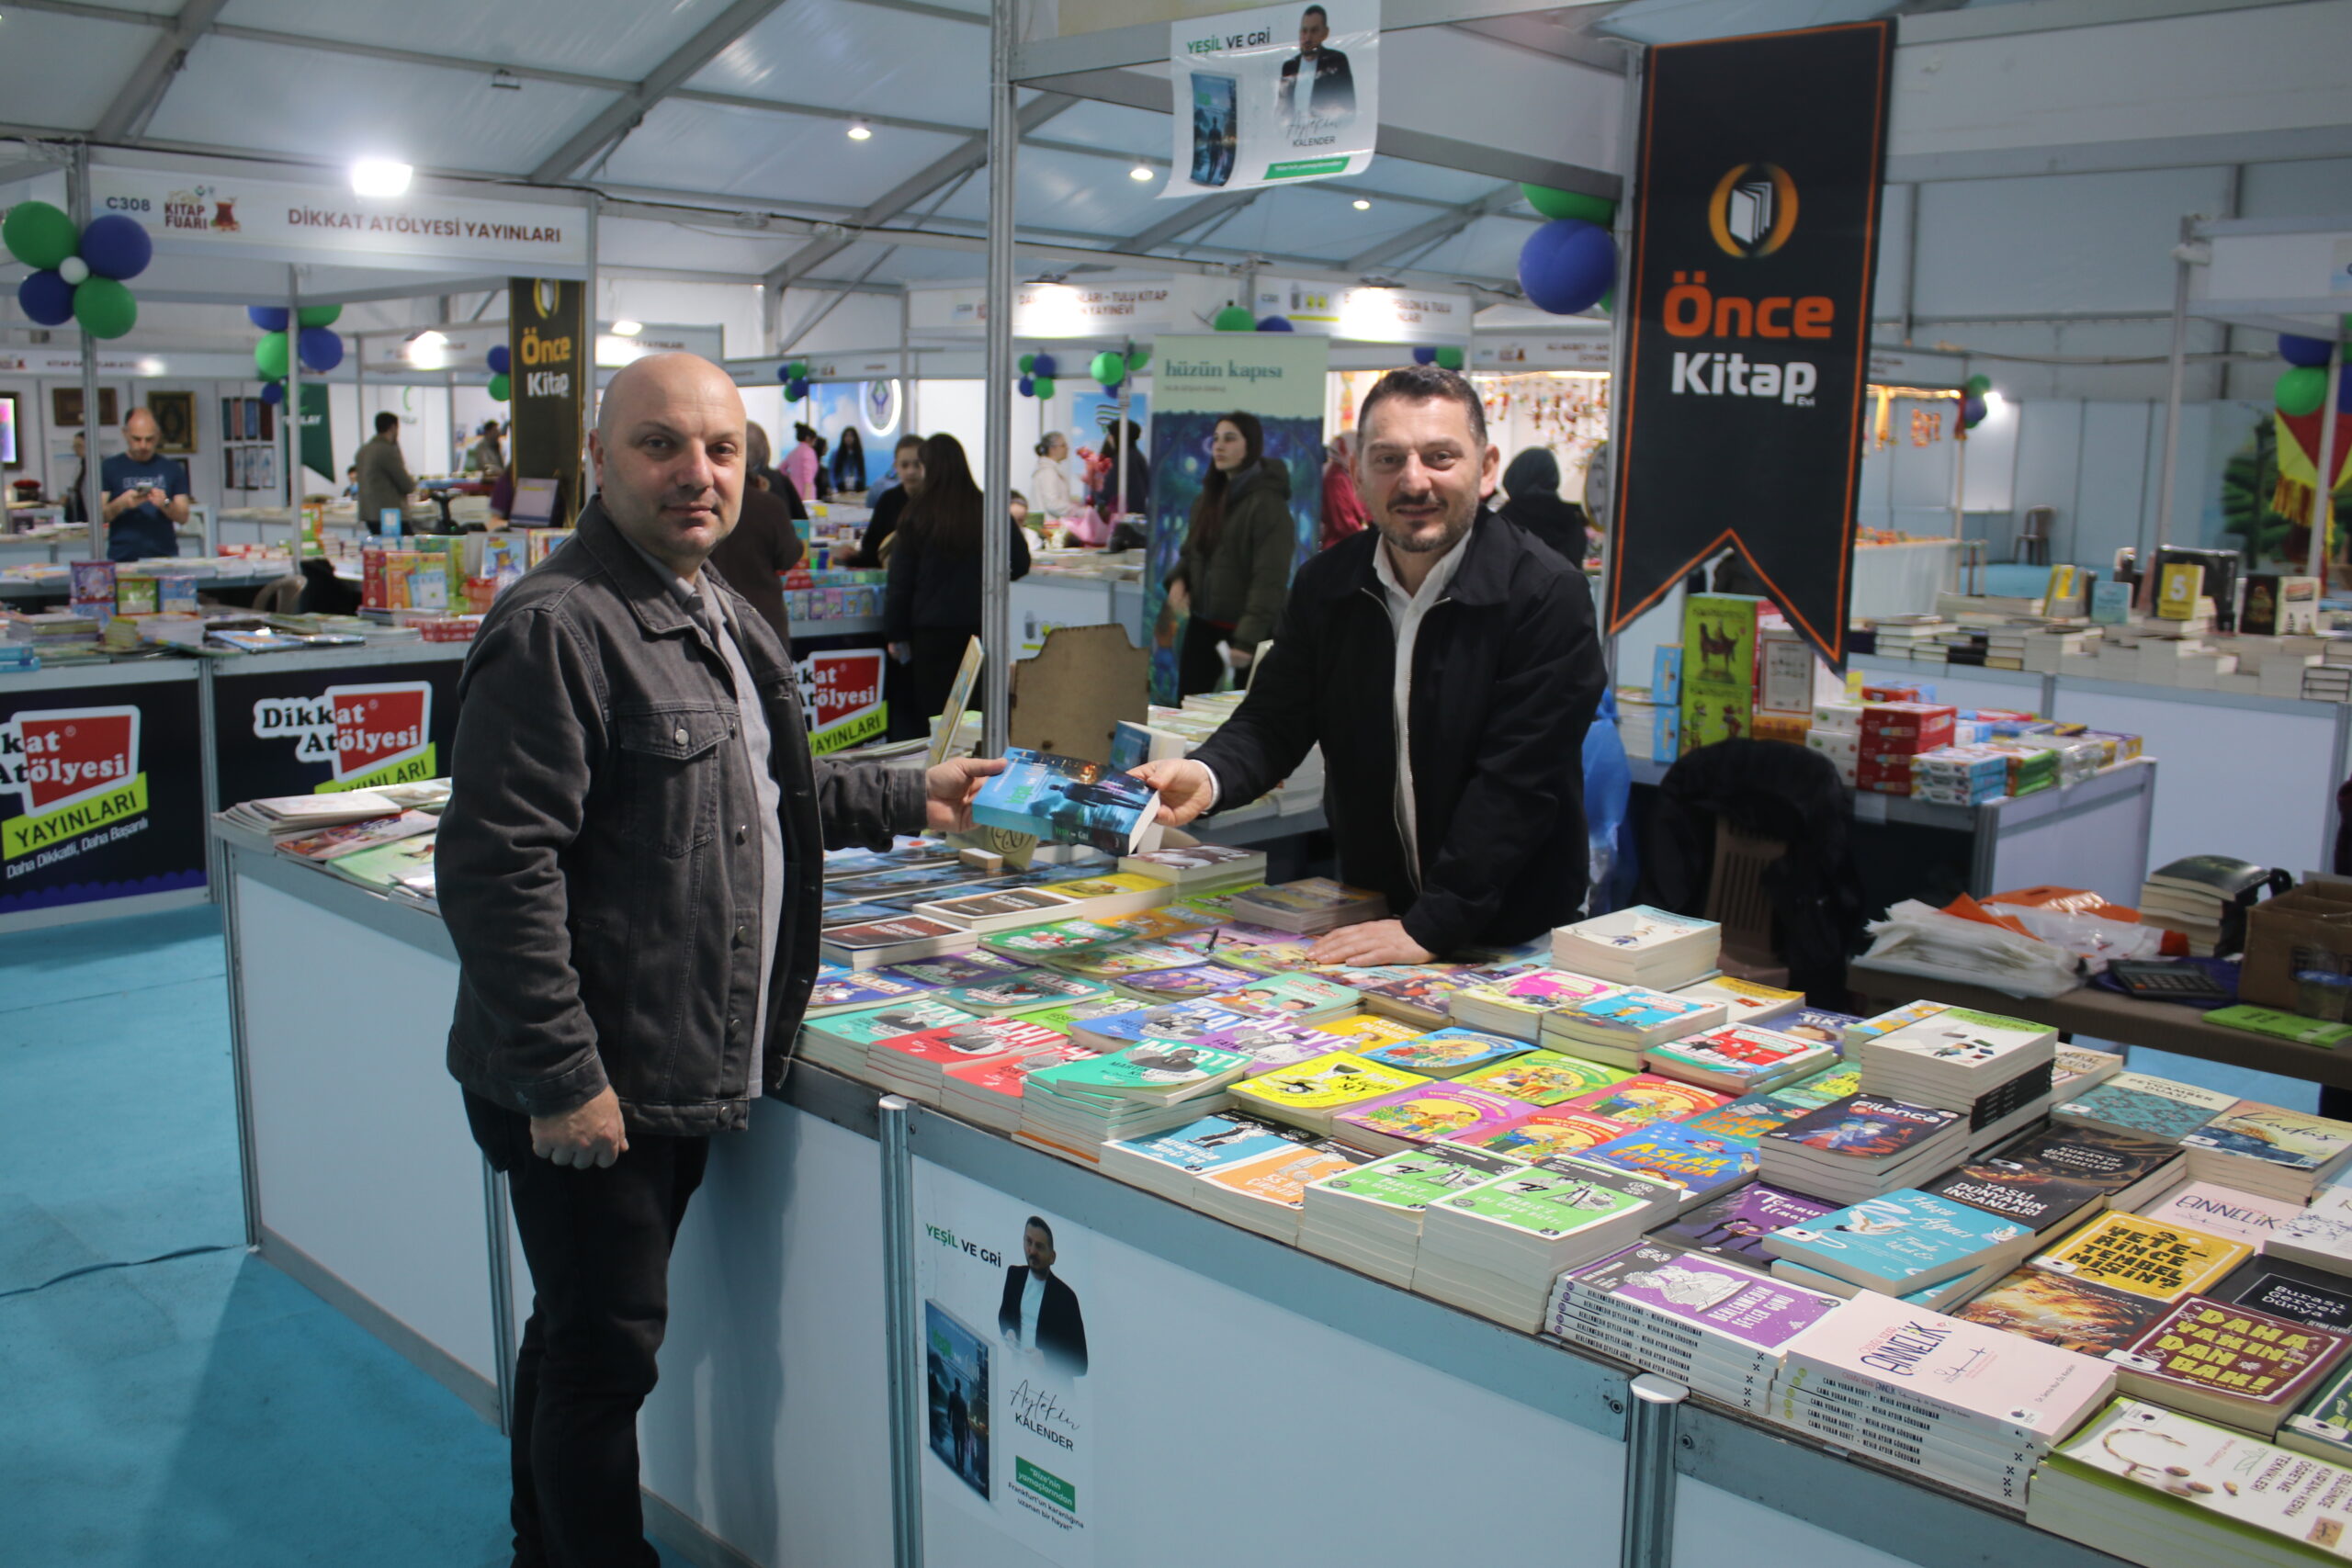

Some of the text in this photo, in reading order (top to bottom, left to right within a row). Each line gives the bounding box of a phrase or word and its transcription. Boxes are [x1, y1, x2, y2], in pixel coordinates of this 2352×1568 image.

[1226, 35, 1243, 49] VE
[1248, 28, 1271, 46] GRİ
[1293, 137, 1335, 147] KALENDER
[106, 196, 152, 212] C308
[288, 206, 561, 243] DİKKAT ATÖLYESİ YAYINLARI
[1663, 271, 1835, 339] Önce
[521, 326, 571, 365] Önce
[1165, 359, 1223, 378] hüzün
[1671, 351, 1817, 405] Kitap
[1797, 397, 1815, 407] Evi
[263, 704, 366, 728] Dikkat
[304, 725, 419, 754] Atölyesi
[15, 790, 138, 848] YAYINLARI
[6, 859, 35, 879] Daha
[82, 832, 108, 852] Daha
[1625, 1143, 1731, 1168] ASLAN
[925, 1224, 1001, 1268] YEŞİL VE GRİ
[2084, 1244, 2184, 1281] TEMBEL
[2261, 1295, 2324, 1317] Dünya
[2268, 1291, 2343, 1315] Gerçek
[2274, 1285, 2346, 1310] Burası
[1661, 1328, 1673, 1337] AYDIN
[1665, 1316, 1677, 1326] AYDIN
[2197, 1308, 2310, 1351] DAHA
[1654, 1351, 1666, 1361] AYDIN
[1656, 1338, 1668, 1349] AYDIN
[1860, 1321, 1951, 1376] ANNELİK
[2154, 1335, 2239, 1367] DAN
[1653, 1362, 1665, 1373] AYDIN
[2166, 1355, 2277, 1391] BAK!
[1817, 1387, 1829, 1397] CAMA
[1832, 1391, 1846, 1403] VURAN
[1849, 1395, 1862, 1407] ROKET
[1888, 1410, 1902, 1421] AYDIN
[1823, 1378, 1836, 1388] CAMA
[1838, 1381, 1853, 1393] VURAN
[1855, 1385, 1871, 1398] ROKET
[1896, 1400, 1910, 1410] AYDIN
[1808, 1409, 1820, 1420] CAMA
[1822, 1413, 1837, 1425] VURAN
[1839, 1418, 1853, 1430] ROKET
[1878, 1433, 1893, 1445] AYDIN
[1811, 1398, 1823, 1409] CAMA
[1825, 1402, 1839, 1414] VURAN
[1841, 1406, 1856, 1419] ROKET
[1882, 1421, 1895, 1433] AYDIN
[1015, 1413, 1074, 1451] KALENDER
[1808, 1419, 1820, 1430] CAMA
[1823, 1424, 1838, 1436] VURAN
[1839, 1429, 1854, 1441] ROKET
[1879, 1444, 1893, 1456] AYDIN
[1042, 1509, 1050, 1519] bir
